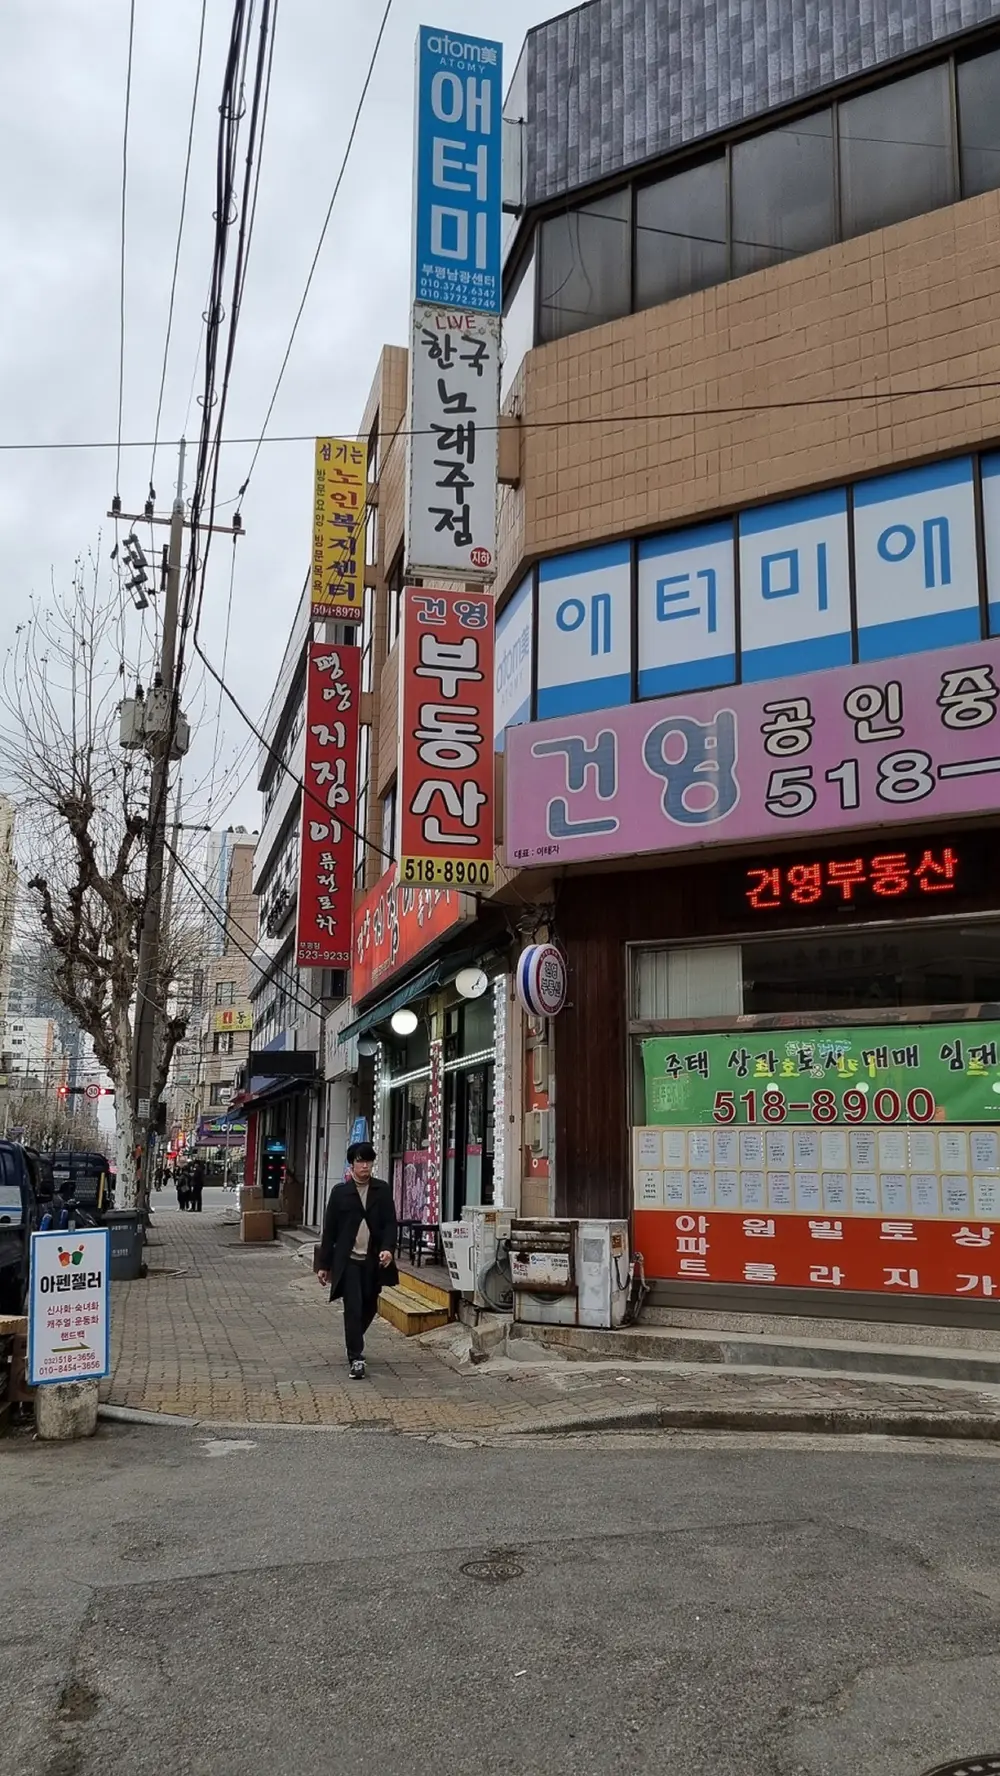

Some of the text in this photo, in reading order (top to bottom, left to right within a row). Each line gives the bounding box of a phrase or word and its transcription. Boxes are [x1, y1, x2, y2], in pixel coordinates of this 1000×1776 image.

[440, 57, 486, 74] ATOMY
[431, 70, 491, 270] 애터미
[420, 278, 496, 298] 010.3747.6347
[420, 288, 496, 308] 010.3772.2749
[435, 315, 477, 330] LIVE
[421, 328, 490, 377] 한국
[319, 443, 364, 465] 섬기는
[428, 378, 477, 548] 노래주점
[471, 551, 491, 566] 지하
[411, 595, 488, 630] 건영
[411, 632, 488, 846] 부동산
[530, 707, 741, 841] 건영
[316, 851, 339, 936] 퓨전포차
[745, 848, 958, 908] 건영부동산
[298, 949, 350, 961] 523-9233
[664, 1050, 710, 1079] 주택
[727, 1047, 780, 1078] 상가
[861, 1043, 920, 1069] 매매
[939, 1038, 998, 1072] 임대
[88, 1087, 98, 1095] 30
[712, 1087, 936, 1124] 518-8900
[675, 1214, 711, 1277] 아파트
[742, 1218, 778, 1282] 원룸
[808, 1220, 846, 1286] 빌라
[879, 1221, 918, 1289] 토지
[951, 1226, 998, 1296] 상가
[40, 1271, 102, 1294] 아펜젤러
[39, 1360, 101, 1376] 010-8454-3656
